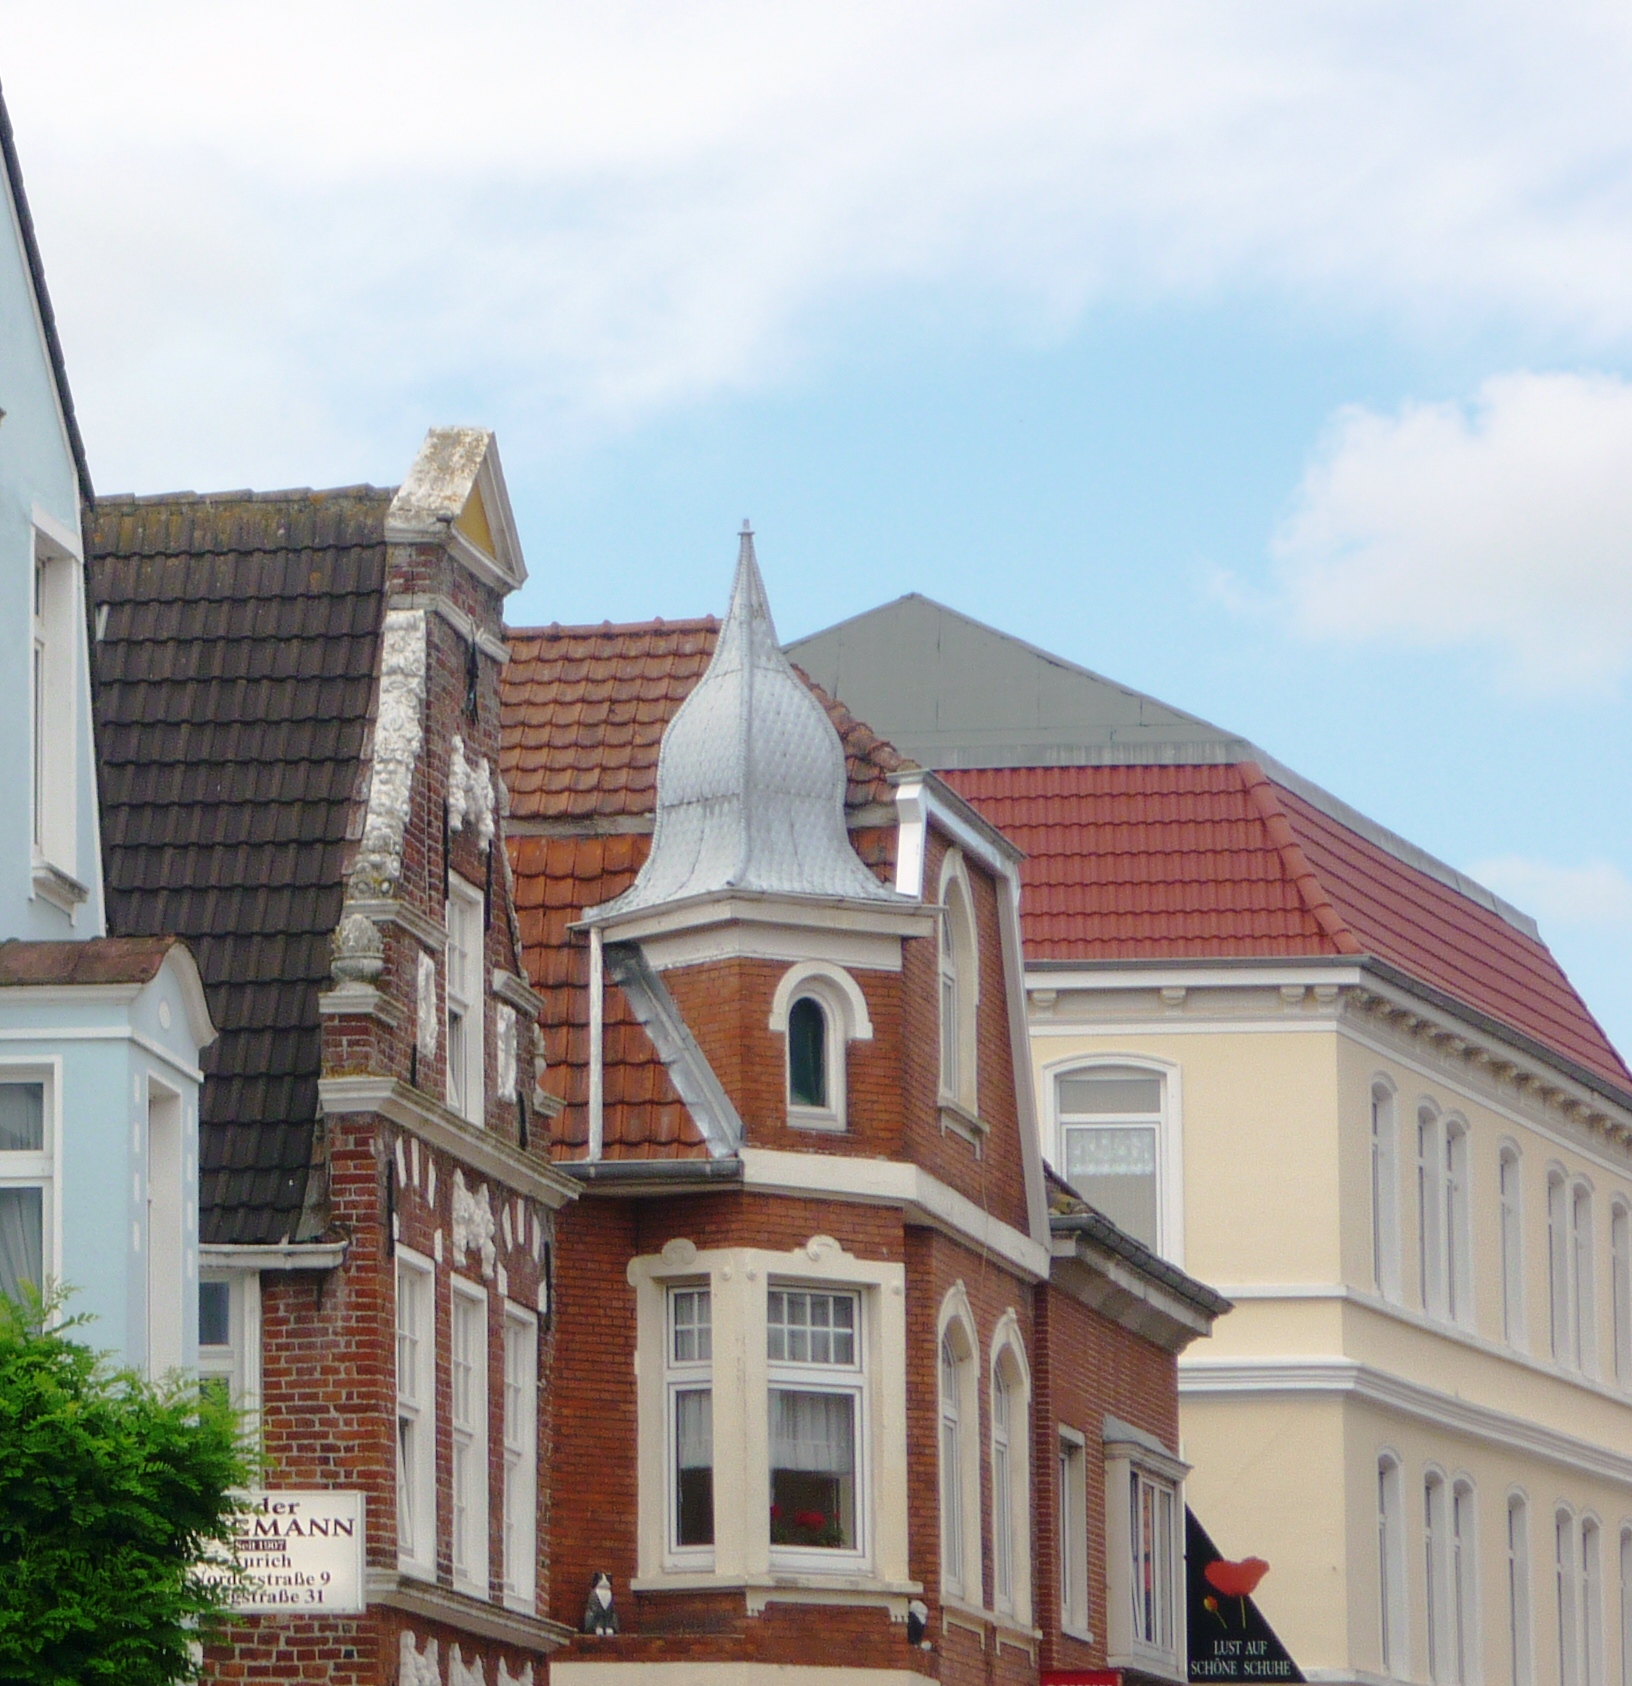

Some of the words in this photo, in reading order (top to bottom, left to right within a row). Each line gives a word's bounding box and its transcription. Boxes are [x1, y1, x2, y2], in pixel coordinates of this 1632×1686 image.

[320, 1571, 331, 1586] 9
[305, 1588, 324, 1604] 31
[1214, 1640, 1242, 1655] LUST
[1245, 1640, 1268, 1655] AUF
[1191, 1658, 1238, 1675] SCHÖNE
[1244, 1660, 1291, 1675] SCHUHE
